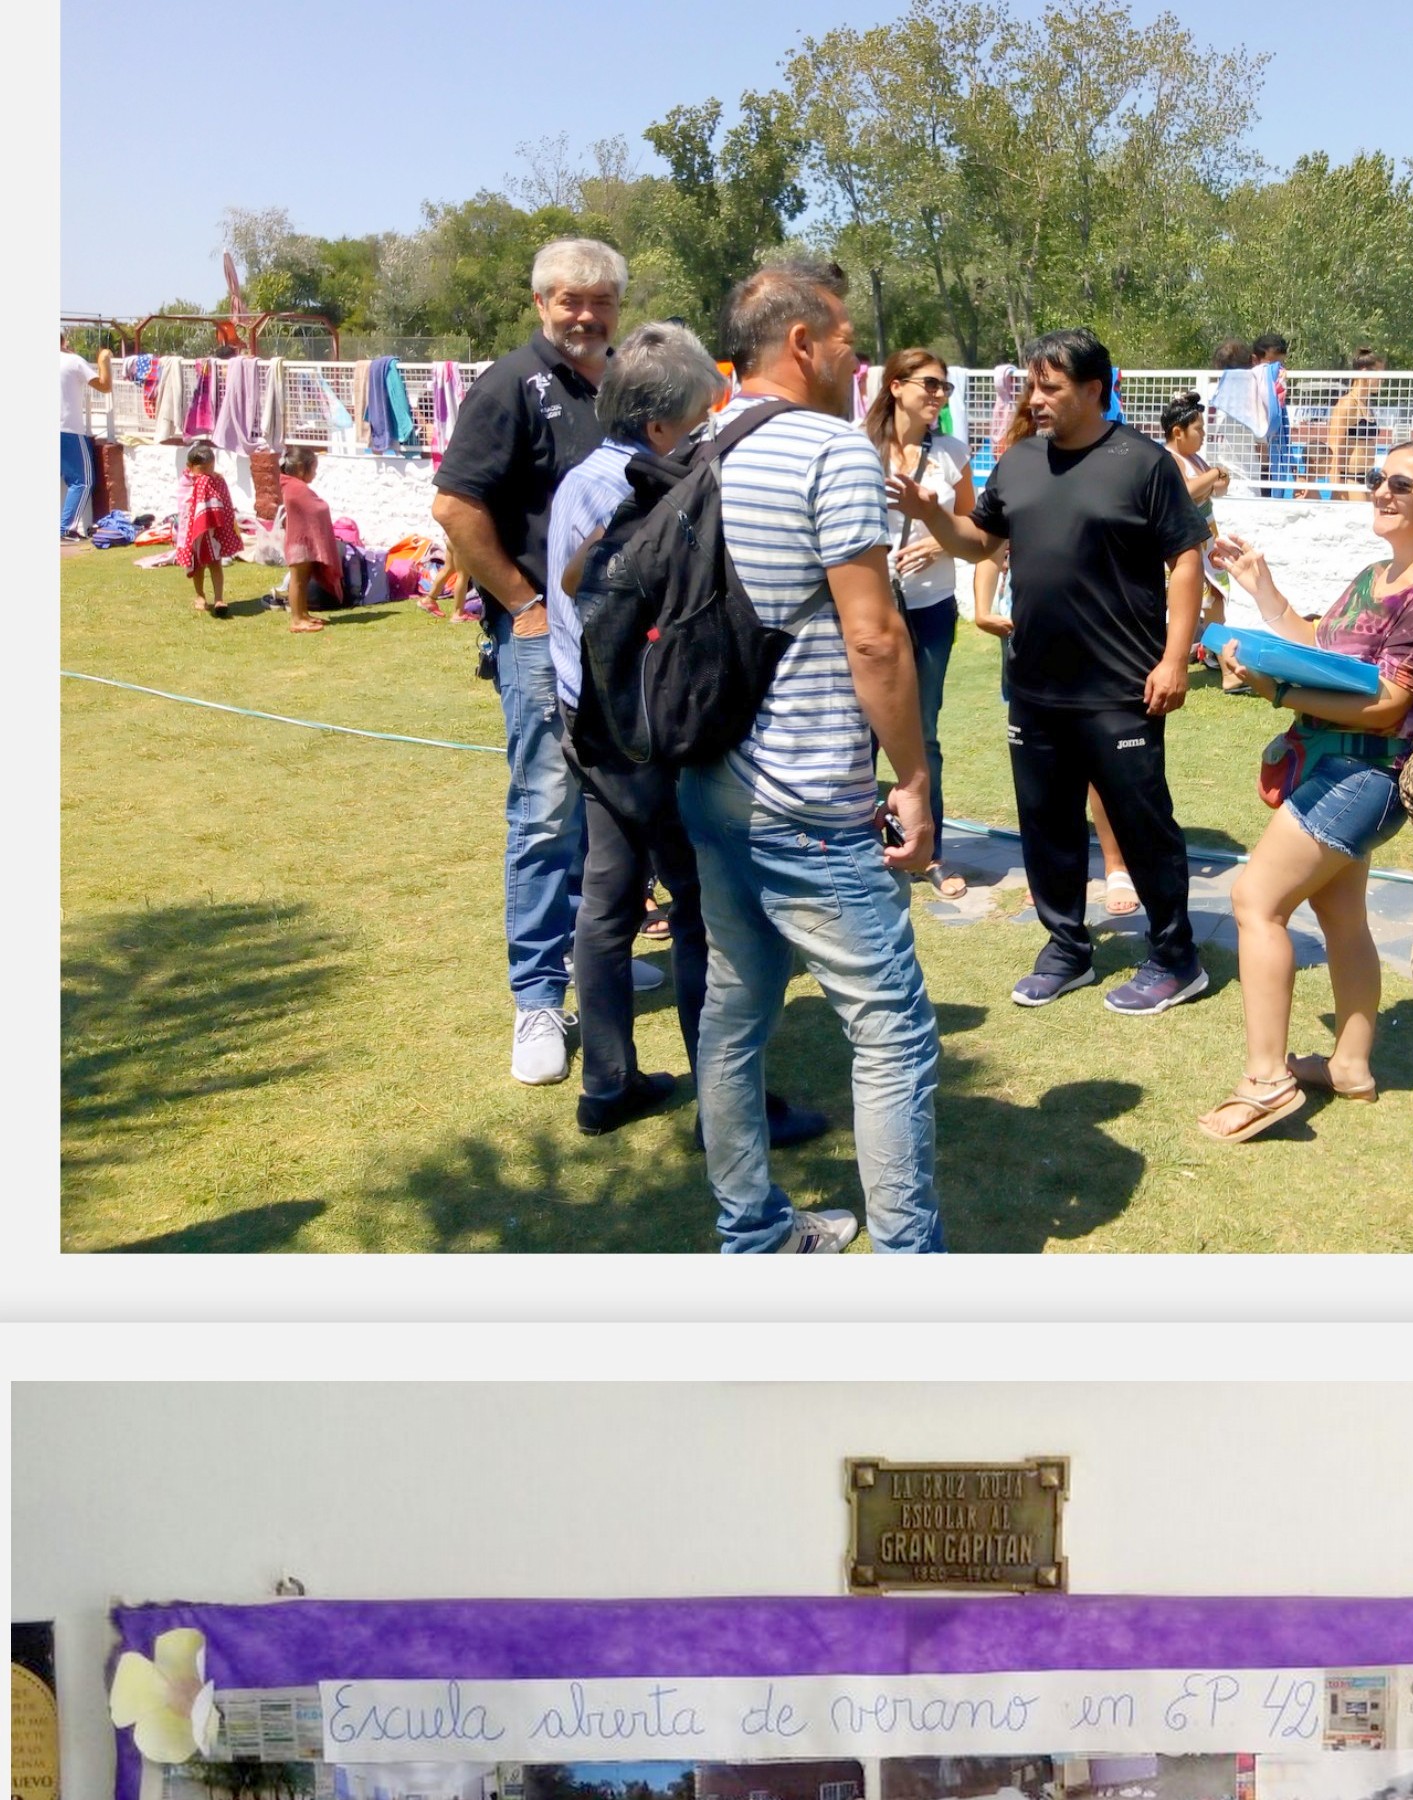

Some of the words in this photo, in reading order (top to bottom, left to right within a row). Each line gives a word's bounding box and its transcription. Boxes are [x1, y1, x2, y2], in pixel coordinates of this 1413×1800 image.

[891, 1473, 912, 1500] LA
[922, 1473, 966, 1500] CRUZ
[978, 1472, 1024, 1500] ROJA
[902, 1503, 978, 1531] ESCOLAR
[991, 1503, 1011, 1531] AL
[880, 1532, 936, 1564] GRAN
[944, 1532, 1033, 1566] CAPITAN
[329, 1680, 506, 1743] Escuela
[740, 1683, 809, 1738] de
[830, 1693, 1041, 1734] verano
[1068, 1693, 1136, 1731] en
[1261, 1673, 1321, 1740] 42
